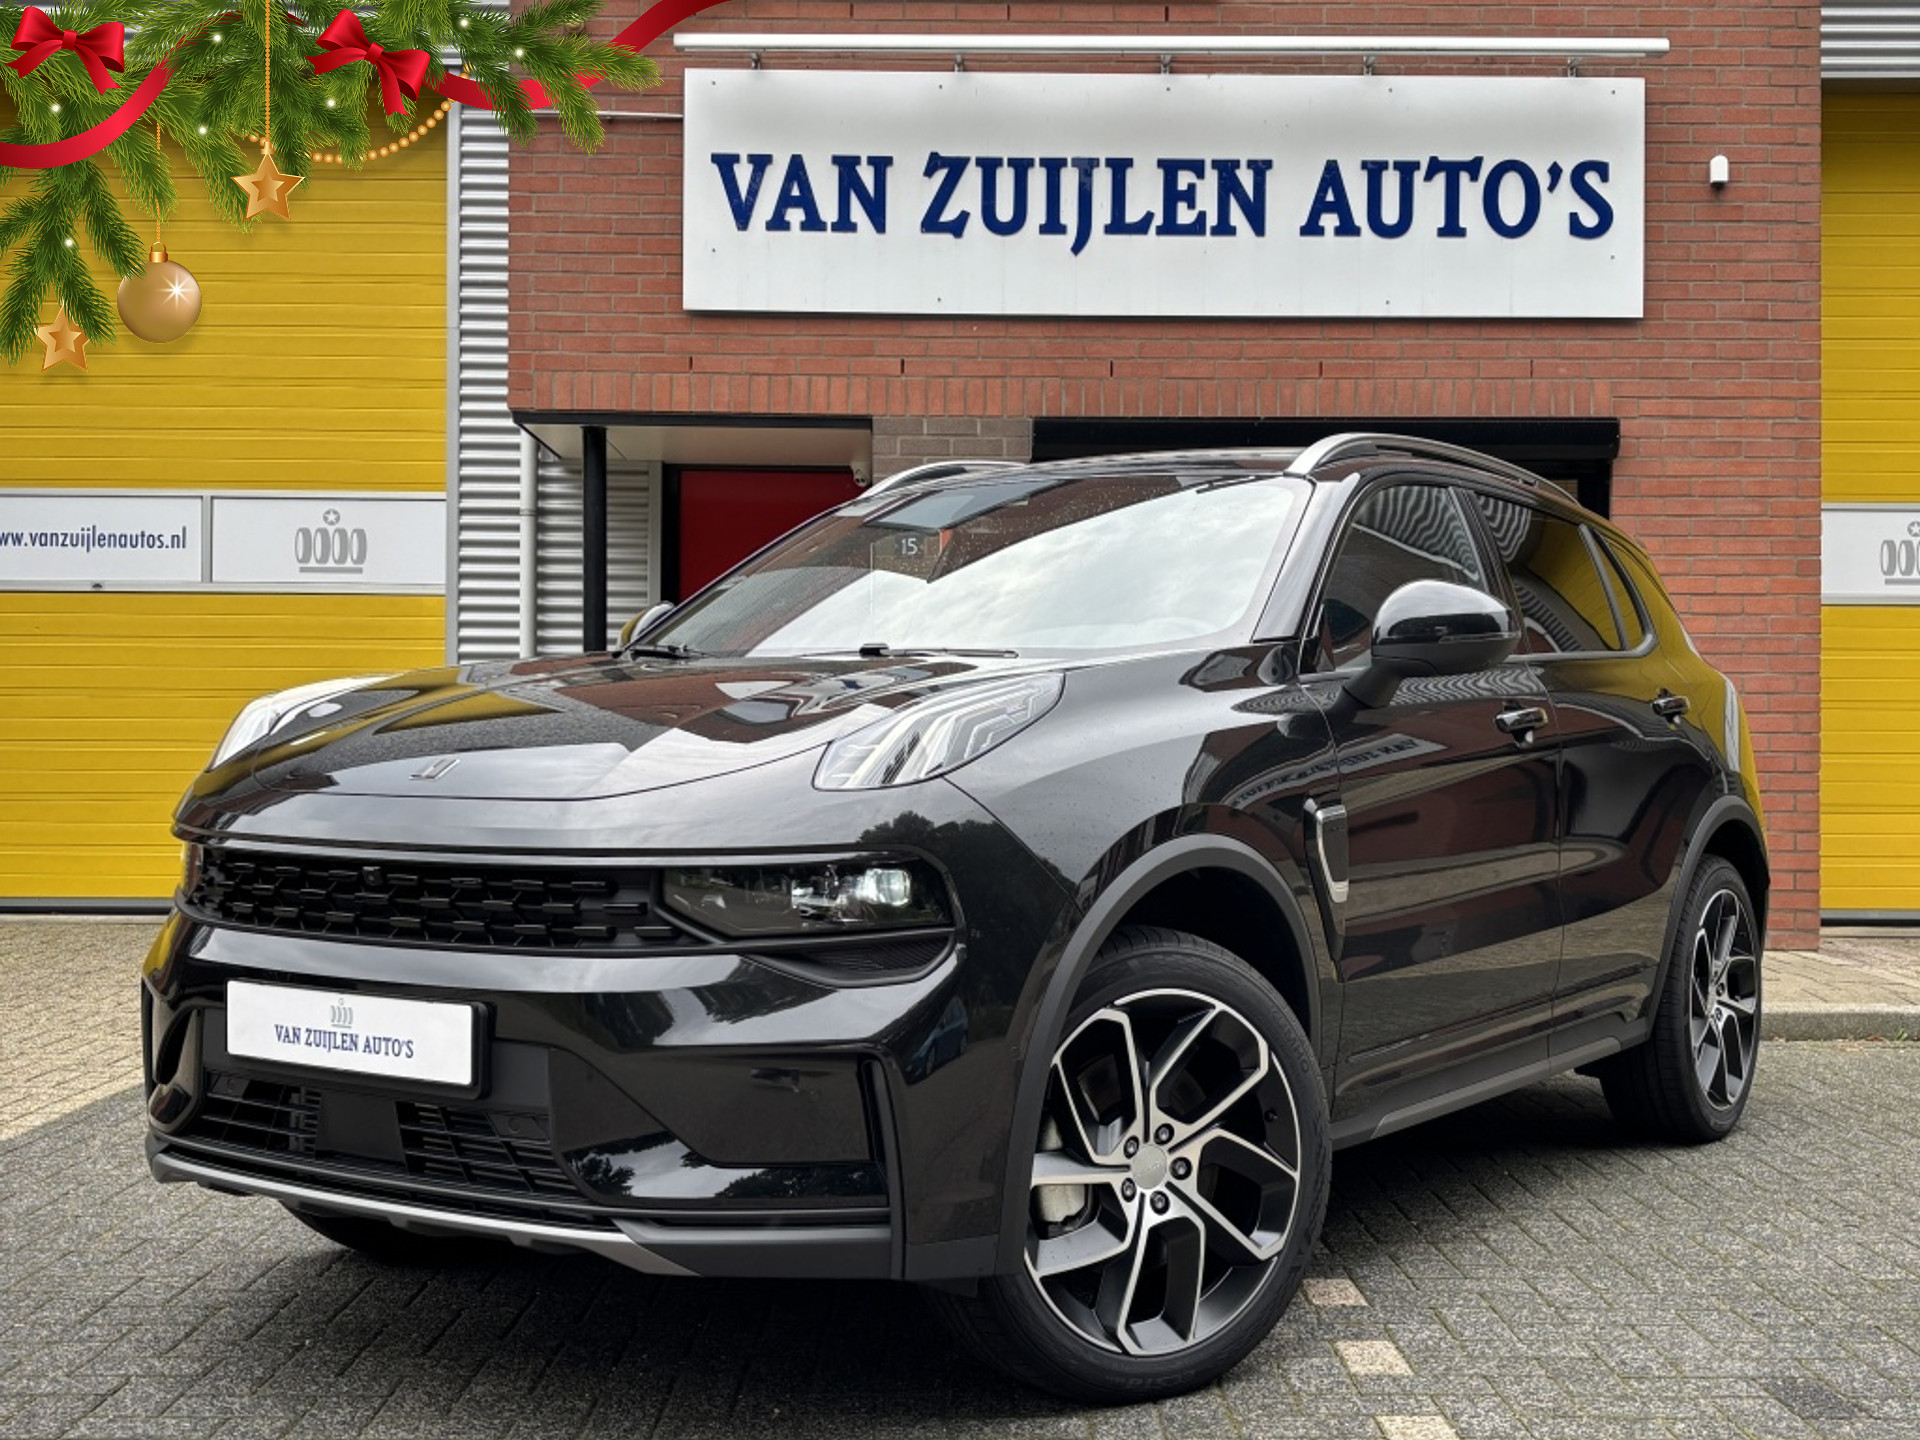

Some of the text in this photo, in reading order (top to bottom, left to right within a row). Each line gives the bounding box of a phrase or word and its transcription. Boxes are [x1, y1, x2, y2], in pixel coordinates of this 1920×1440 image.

[710, 151, 1615, 257] VAN ZUIJLEN AUTO'S
[901, 537, 918, 555] 15
[274, 1023, 414, 1059] VAN ZUIJLEN AUTO'S
